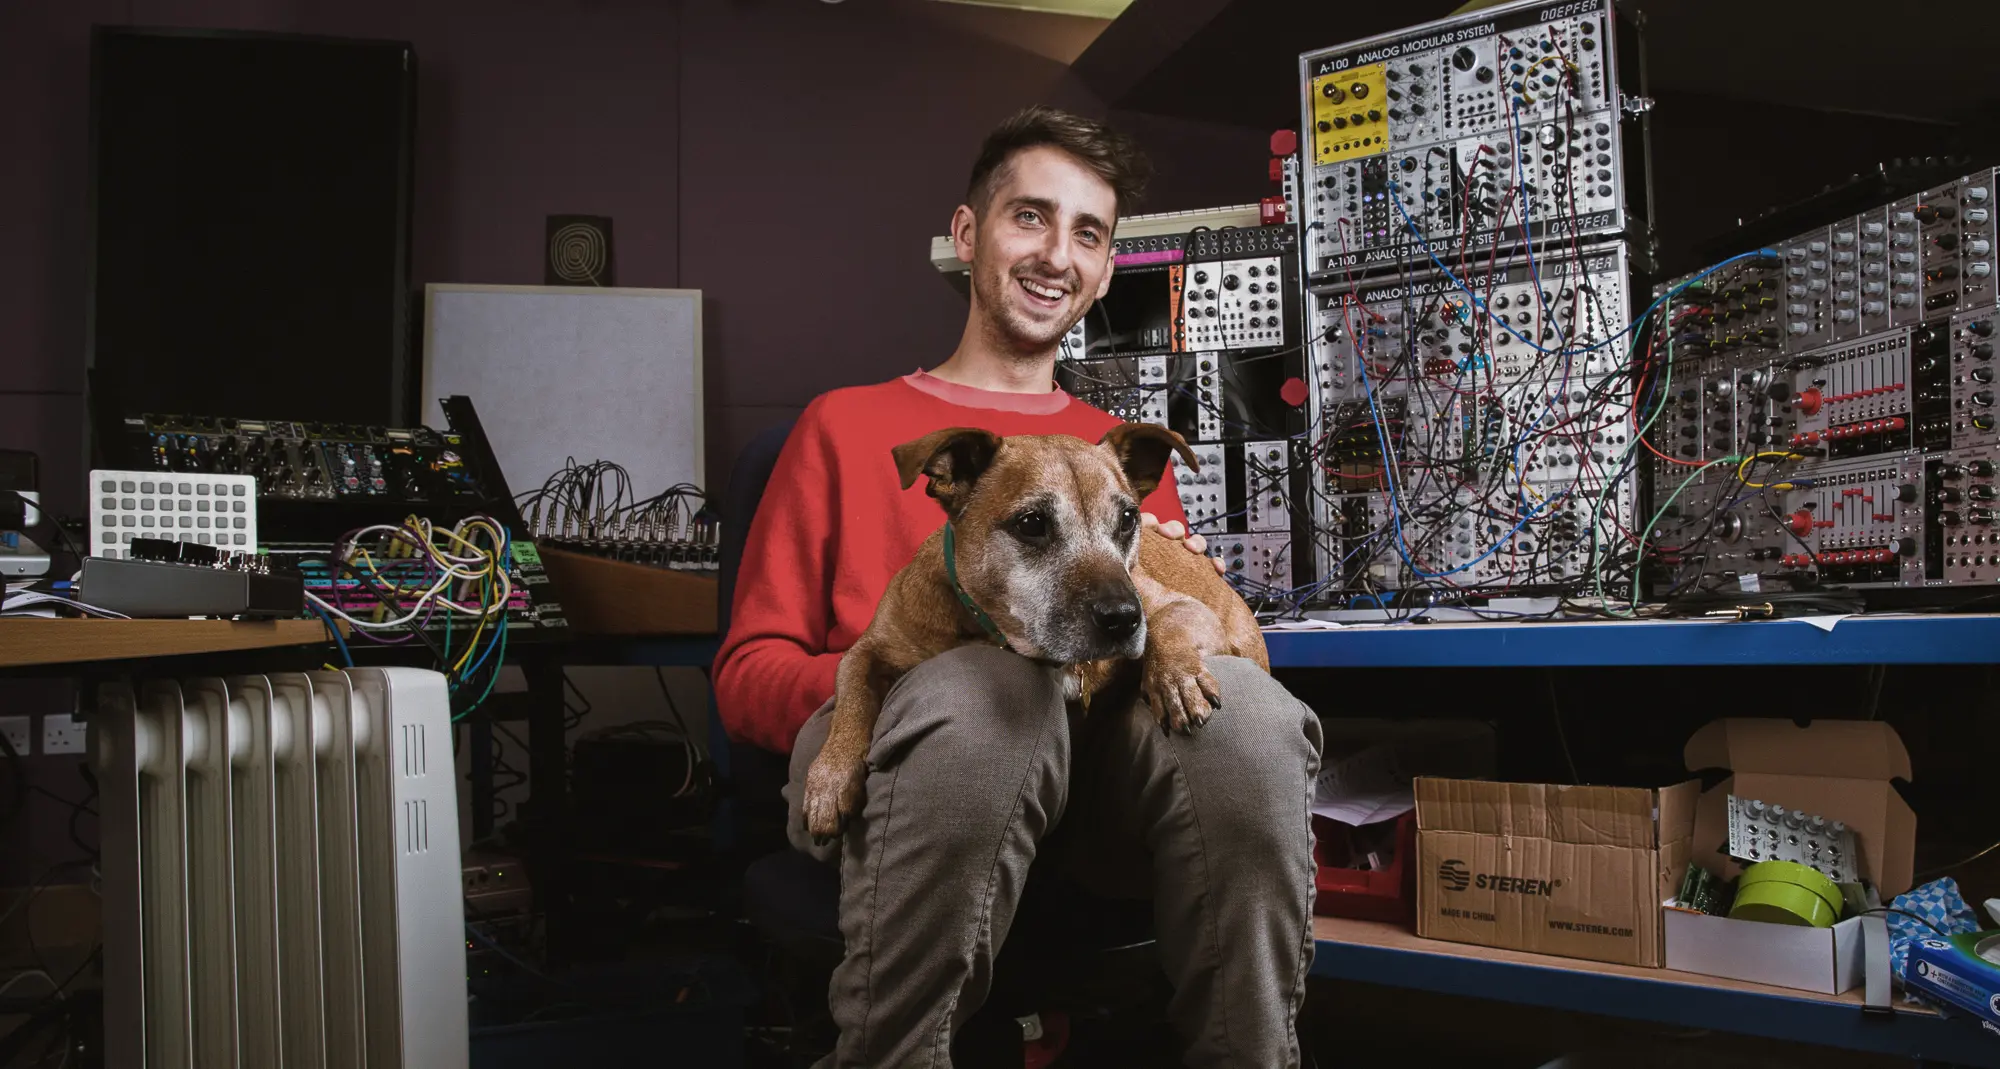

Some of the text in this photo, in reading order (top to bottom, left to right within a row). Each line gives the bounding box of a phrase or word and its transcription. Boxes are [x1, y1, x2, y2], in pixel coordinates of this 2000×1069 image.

[1541, 0, 1597, 21] DOEPFER
[1319, 58, 1349, 74] A-100
[1357, 46, 1400, 65] ANALOG
[1402, 33, 1454, 54] MODULAR
[1456, 23, 1495, 41] SYSTEM
[1551, 214, 1609, 233] DOPFER
[1327, 255, 1357, 269] A-100
[1365, 246, 1408, 263] ANALOG
[1467, 231, 1505, 246] SSTEM
[1468, 272, 1507, 288] SYSEM
[1440, 907, 1496, 922] MADE IN CHINA
[1549, 920, 1633, 938] WWW.STEREN.COM
